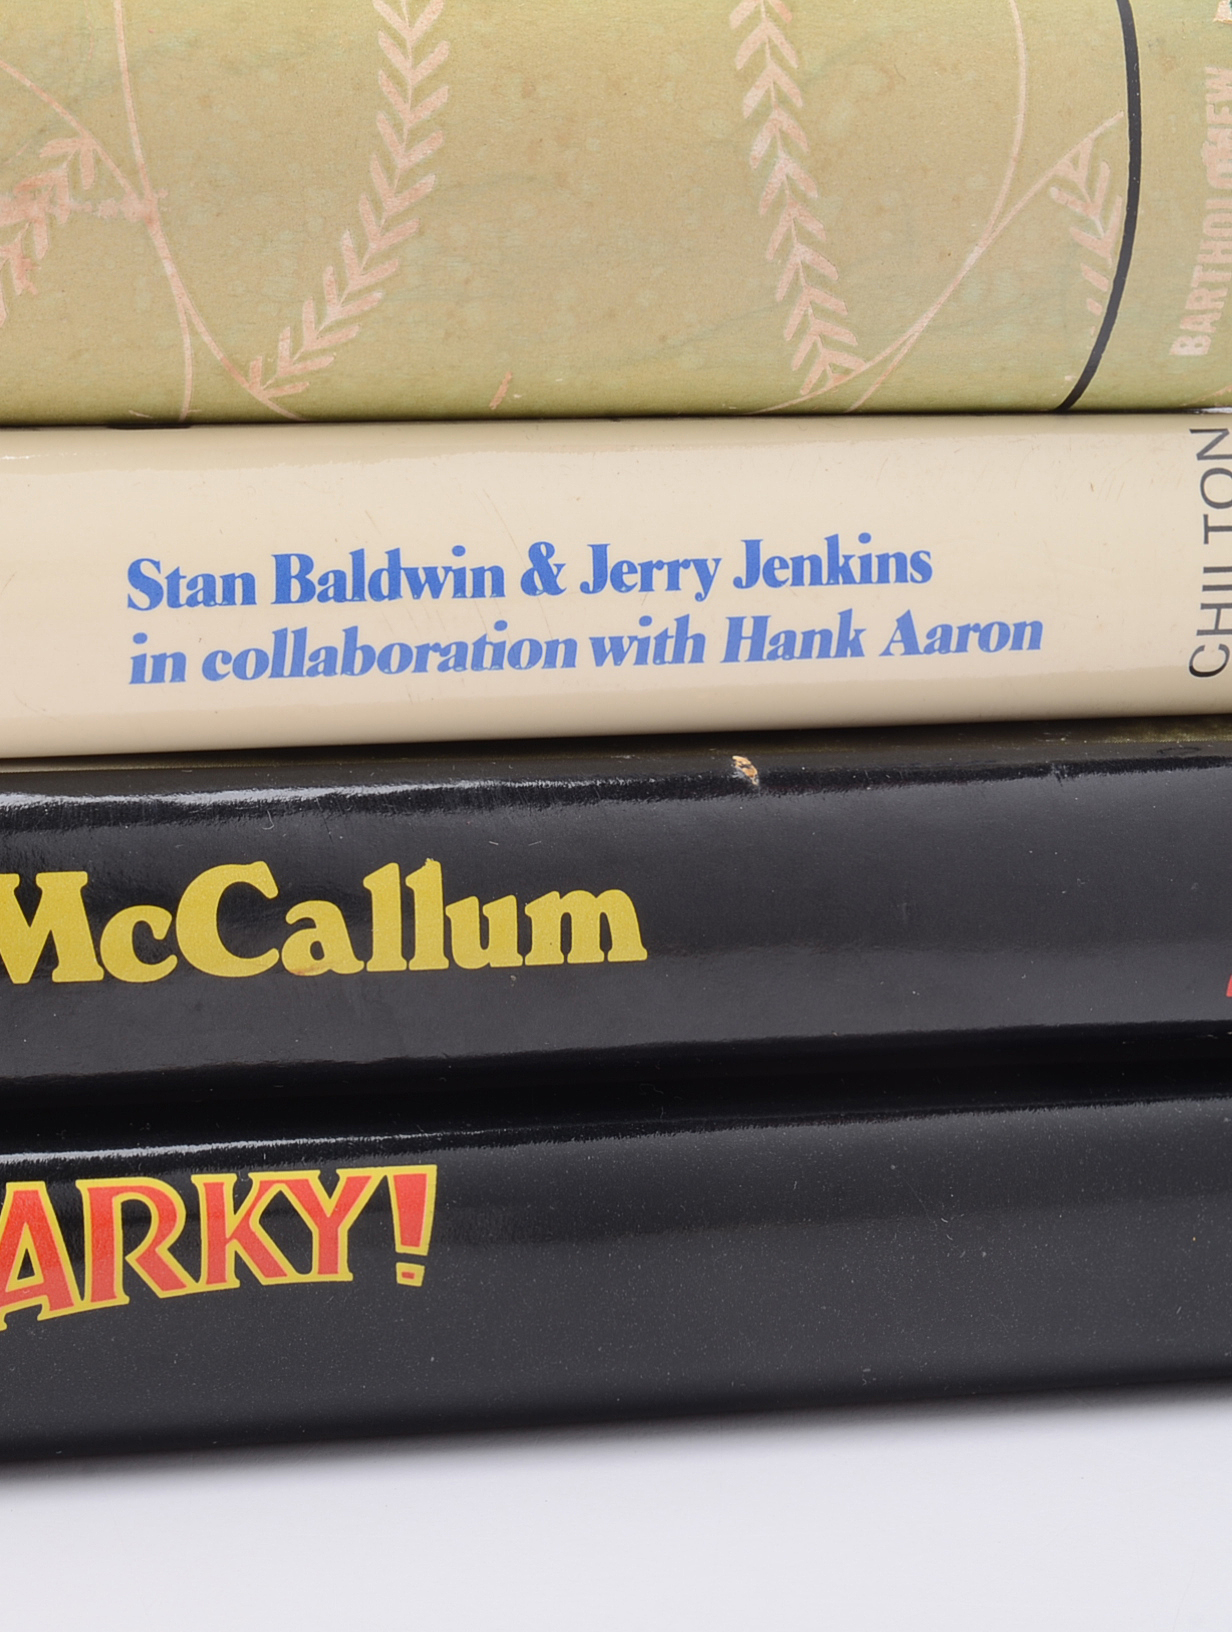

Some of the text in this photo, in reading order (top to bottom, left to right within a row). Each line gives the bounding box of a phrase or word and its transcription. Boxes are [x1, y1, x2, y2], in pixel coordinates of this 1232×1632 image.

[127, 532, 933, 611] Stan Baldwin & Jerry Jenkins
[1188, 428, 1232, 678] CHILTON
[129, 608, 1043, 684] in collaboration with Hank Aaron
